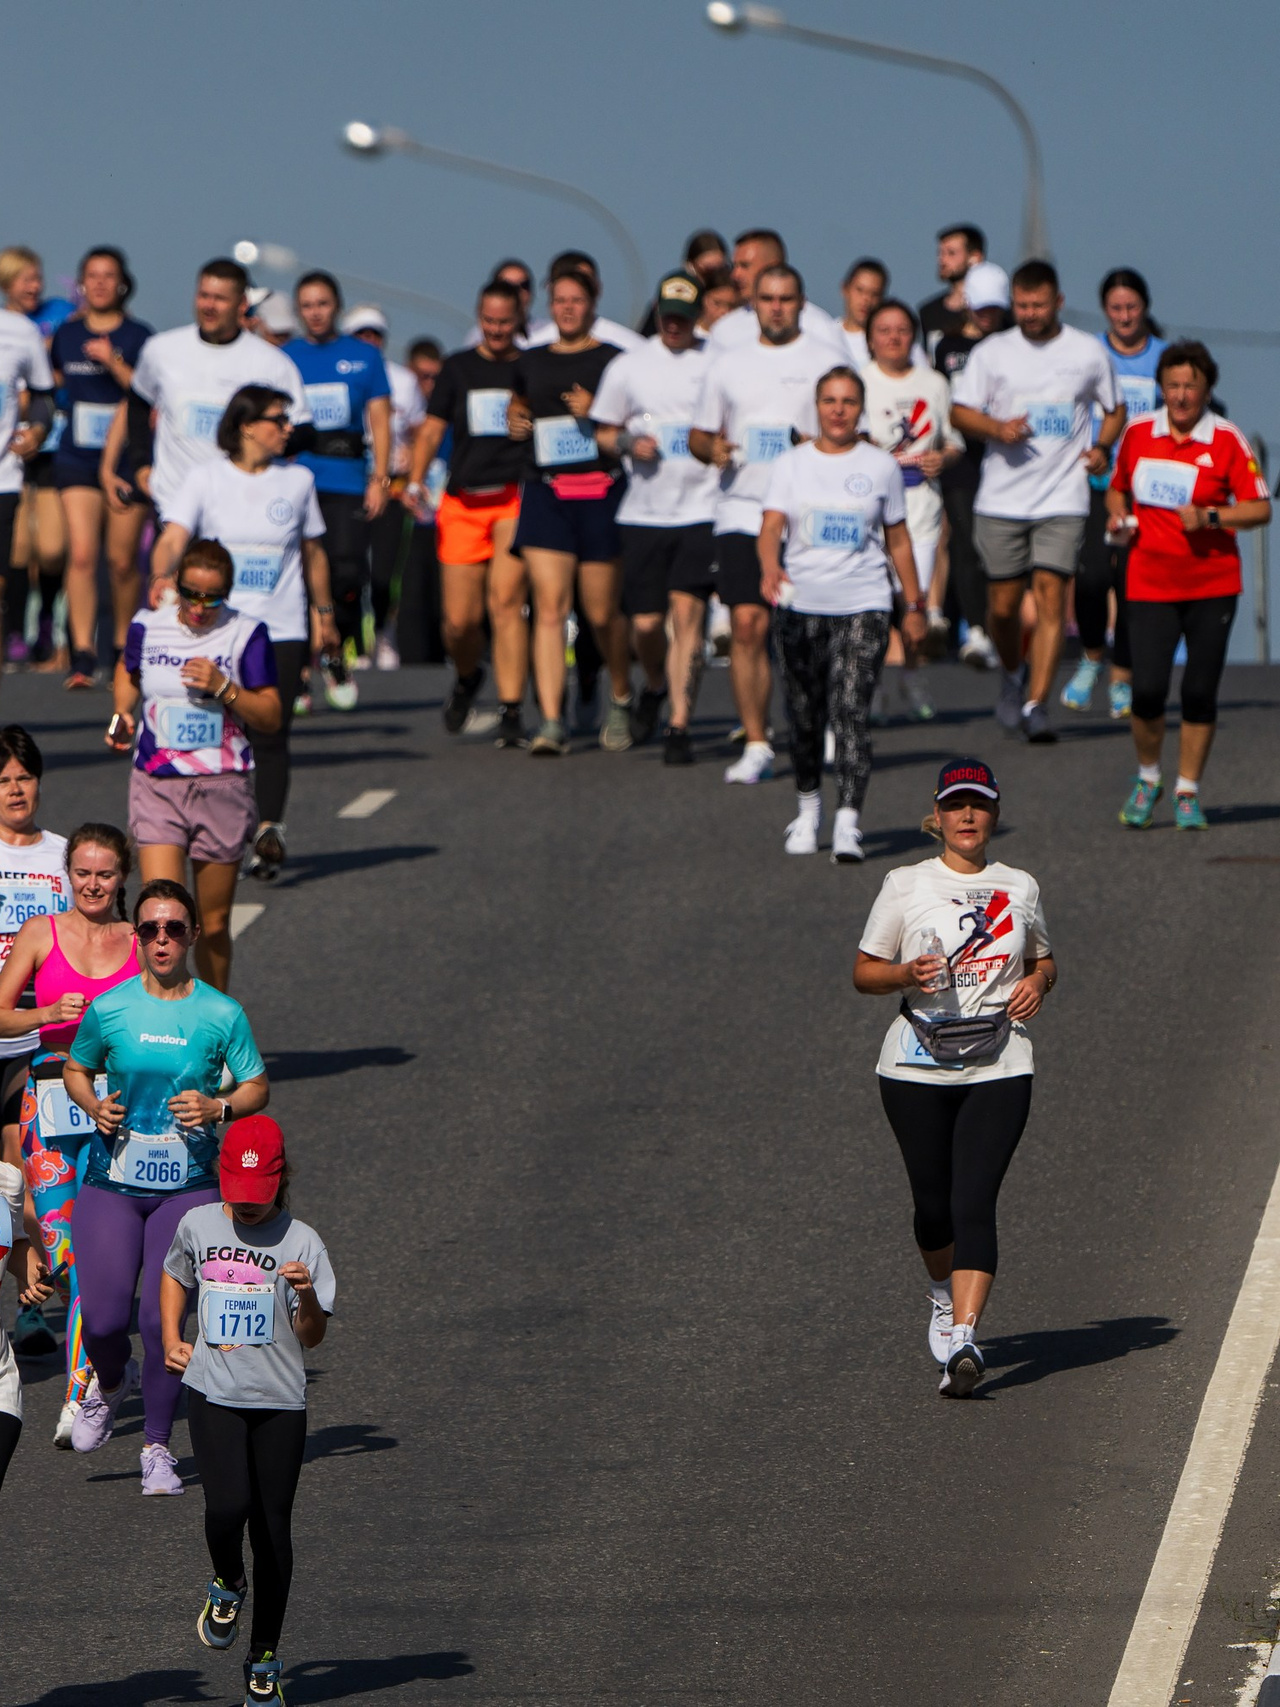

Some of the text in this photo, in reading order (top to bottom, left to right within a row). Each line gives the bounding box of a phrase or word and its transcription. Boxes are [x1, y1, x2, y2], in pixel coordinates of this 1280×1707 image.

[177, 722, 216, 743] 2521
[140, 1033, 187, 1046] Pandora
[148, 1149, 169, 1159] НИНА
[135, 1160, 181, 1183] 2066
[198, 1246, 277, 1272] LEGEND
[224, 1299, 257, 1311] ГЕРМАН
[219, 1313, 266, 1337] 1712
